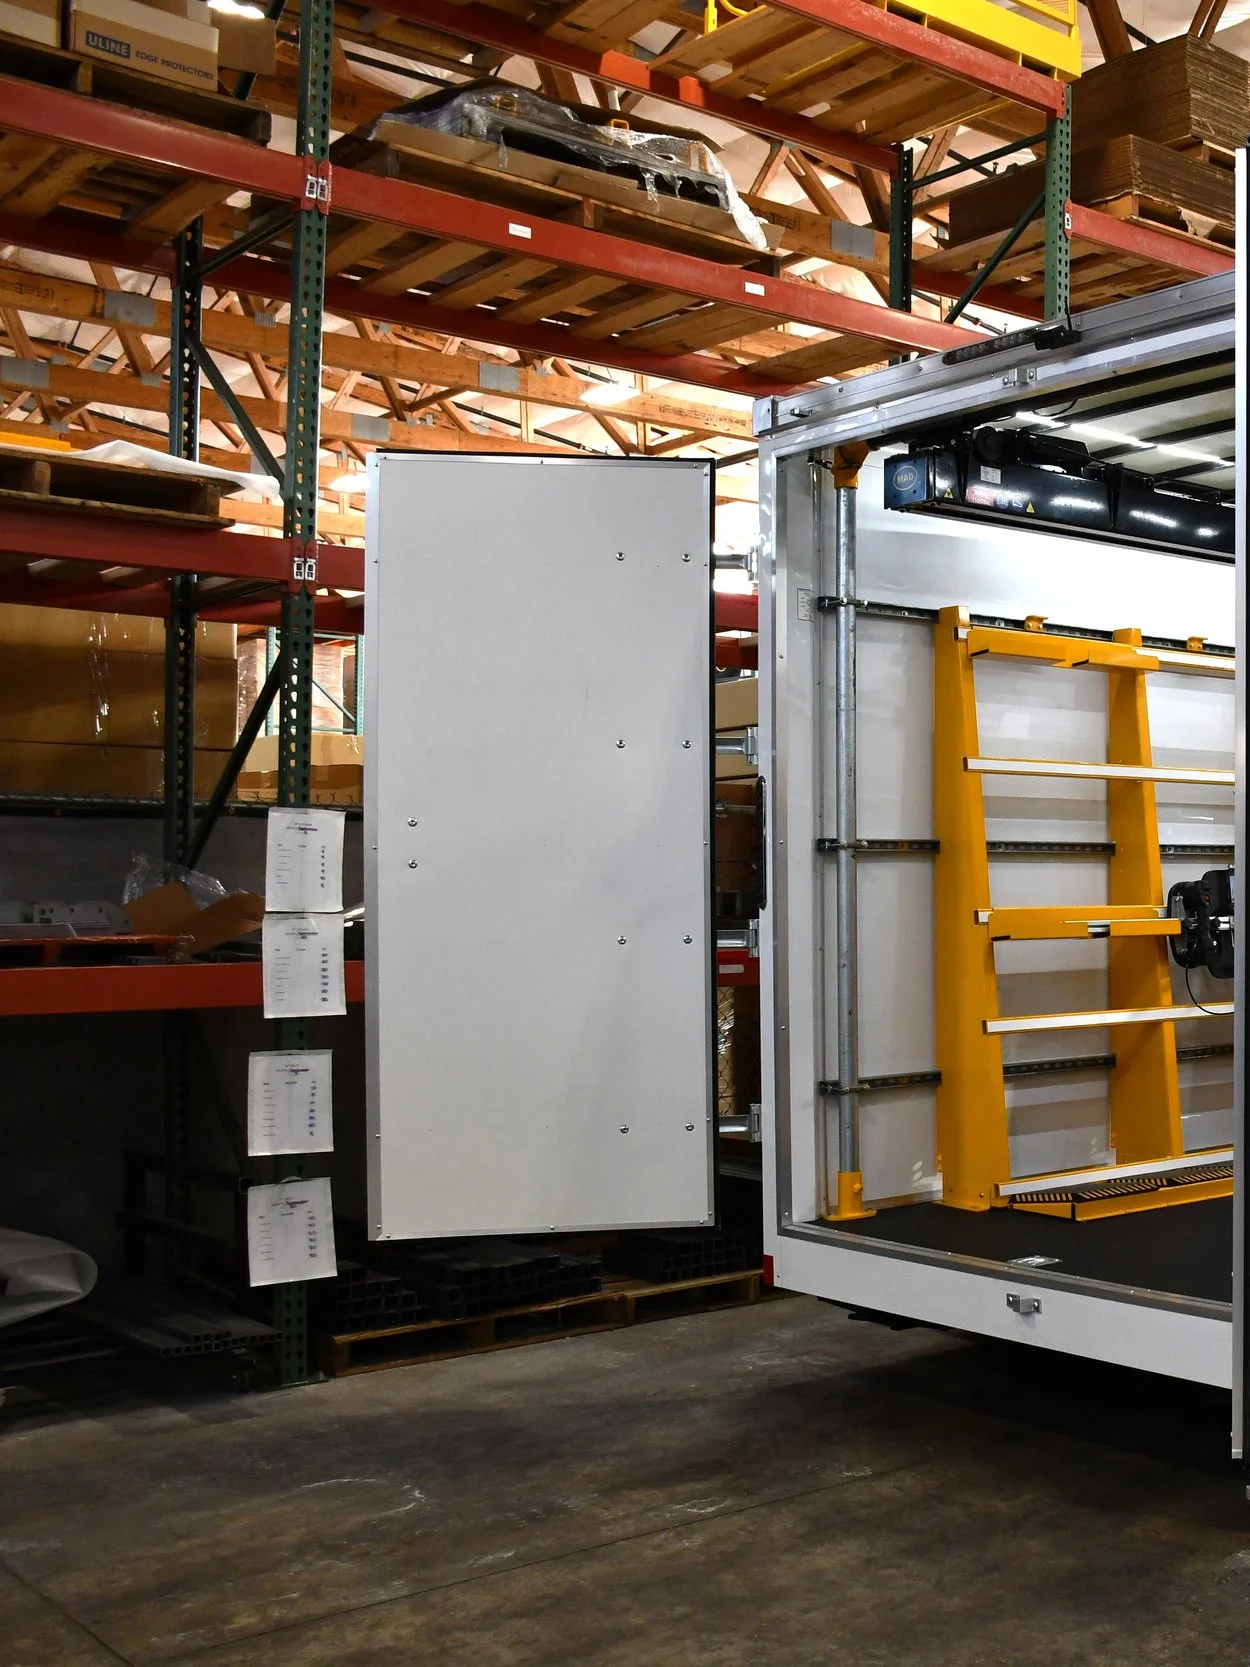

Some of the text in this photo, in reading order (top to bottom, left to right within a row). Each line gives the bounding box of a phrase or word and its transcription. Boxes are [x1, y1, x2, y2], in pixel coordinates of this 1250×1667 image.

[88, 33, 214, 81] ULINE EDGE PROTECTORS
[897, 474, 914, 484] MAD
